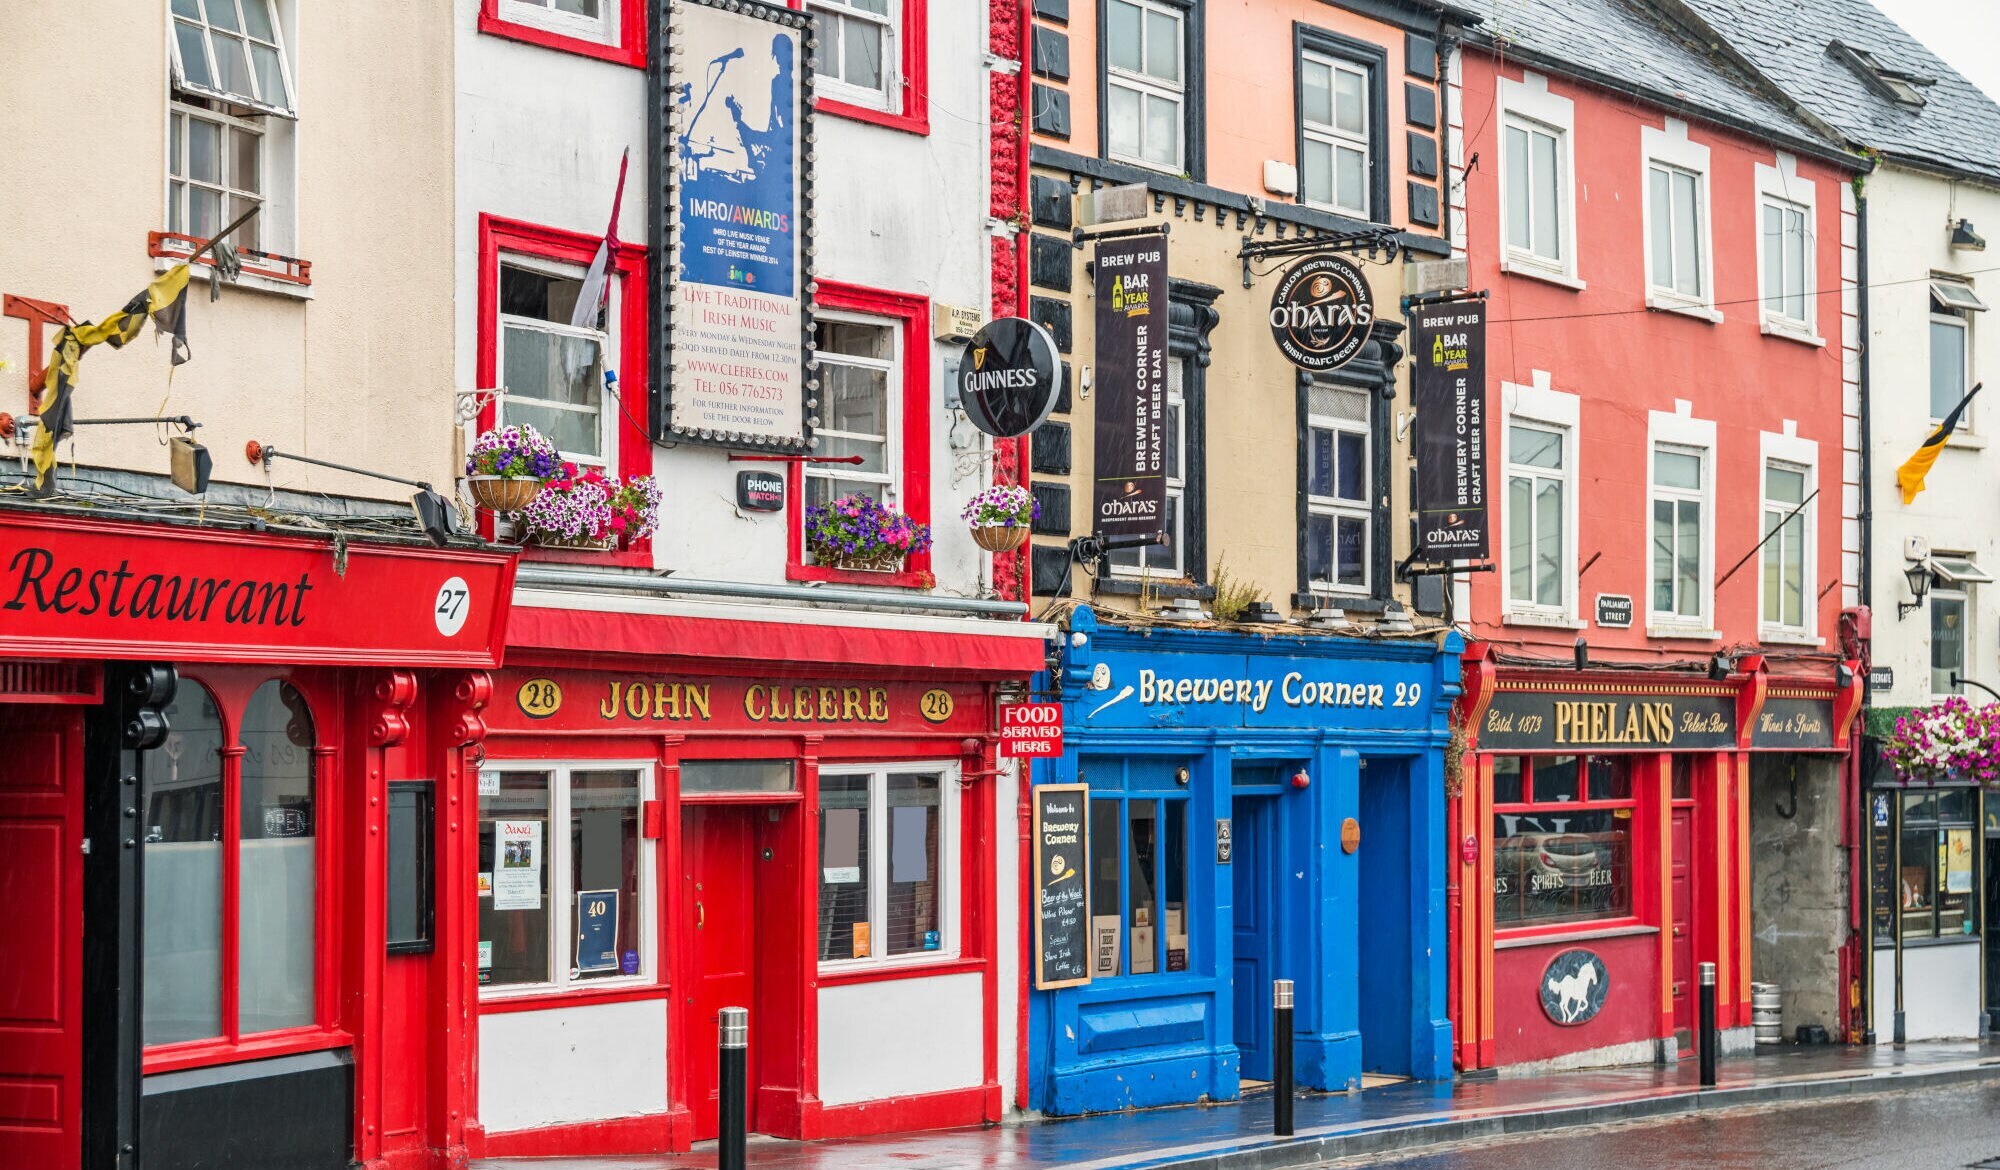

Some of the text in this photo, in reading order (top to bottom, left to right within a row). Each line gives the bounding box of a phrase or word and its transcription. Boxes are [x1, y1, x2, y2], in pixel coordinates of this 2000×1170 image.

[690, 197, 789, 233] IMRO/AWARDS
[713, 228, 771, 245] IMRO LIVE MUSIC VENUE
[717, 238, 767, 253] OF THE YEAR AWARD
[702, 245, 716, 254] REST
[717, 247, 725, 256] OF
[725, 249, 749, 260] LEINSTER
[749, 253, 768, 263] WINNER
[1101, 251, 1161, 268] BREW PUB
[1124, 273, 1149, 290] BAR
[1278, 261, 1367, 304] CARLOW BREWING COMPANY
[684, 286, 792, 316] LIVE TRADITIONAL
[1124, 292, 1149, 305] YEAR
[703, 308, 777, 333] IRISH MUSIC
[1423, 314, 1479, 328] BREW PUB
[699, 330, 730, 342] MONDAY
[731, 333, 737, 343] &
[738, 334, 775, 348] WEDNESDAY
[776, 340, 797, 351] NIGHT
[1443, 333, 1468, 347] BAR
[681, 343, 700, 353] OOD
[701, 344, 728, 356] SERVED
[729, 348, 749, 359] DAILY
[751, 351, 770, 361] FROM
[1283, 336, 1359, 366] IRISH CRAFT BEERS
[1444, 349, 1467, 360] YEAR
[687, 359, 790, 383] WWW.CLEERES.COM
[964, 369, 1037, 393] GUINNESS
[694, 378, 783, 402] TEL: 056 7762573
[1136, 324, 1148, 472] BREWERY CORNER
[692, 397, 785, 416] FOR FURTHER INFORMATION
[1151, 349, 1162, 471] CRAFT BEER BAR
[703, 412, 774, 427] USE THE DOOR BELOW
[1456, 377, 1468, 505] BREWERY CORNER
[1471, 398, 1482, 504] CRAFT BEER BAR
[747, 479, 782, 493] PHONE
[748, 491, 775, 502] WATCH
[2, 547, 314, 627] Restaurant
[437, 589, 466, 620] 27
[1600, 599, 1630, 609] PARLIAMENT
[1605, 611, 1626, 621] STREET
[527, 682, 555, 708] 28
[600, 681, 889, 724] JOHN CLEERE
[926, 691, 950, 715] 28
[1392, 681, 1421, 708] 29
[1005, 706, 1058, 724] FOOD
[1487, 708, 1543, 735] Estd. 1873
[1553, 701, 1675, 744] PHELANS
[1680, 711, 1728, 733] Select Bar
[1001, 725, 1062, 739] SERVED
[1760, 712, 1821, 740] Wines & Spirits
[1012, 739, 1051, 753] HERE
[264, 811, 305, 834] OPEN
[1531, 873, 1564, 891] SPIRITS
[1590, 869, 1613, 887] BEER
[587, 901, 607, 918] 40
